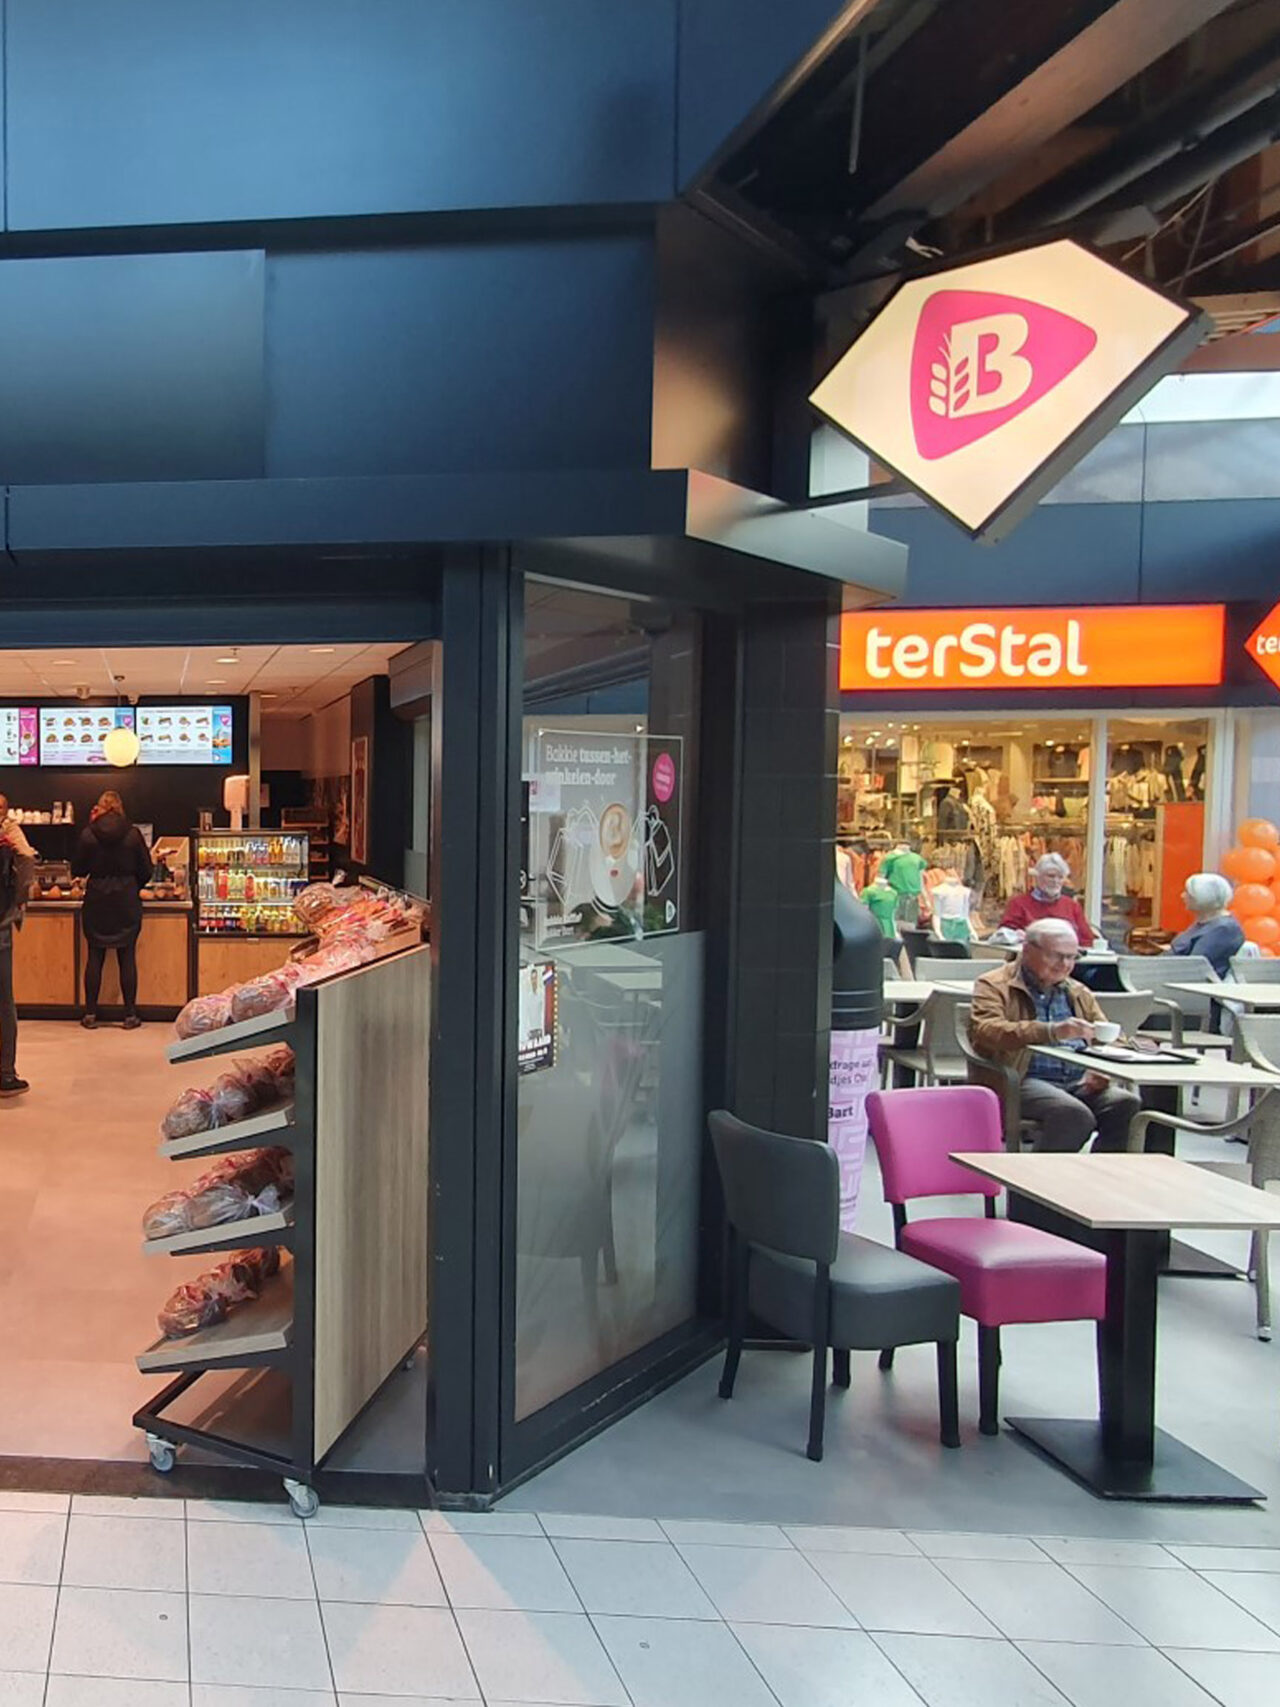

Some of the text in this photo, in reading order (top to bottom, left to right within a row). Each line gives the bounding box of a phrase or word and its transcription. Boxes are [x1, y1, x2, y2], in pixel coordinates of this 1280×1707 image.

[929, 312, 1033, 419] B
[865, 620, 1088, 679] terStal
[1256, 634, 1280, 655] te
